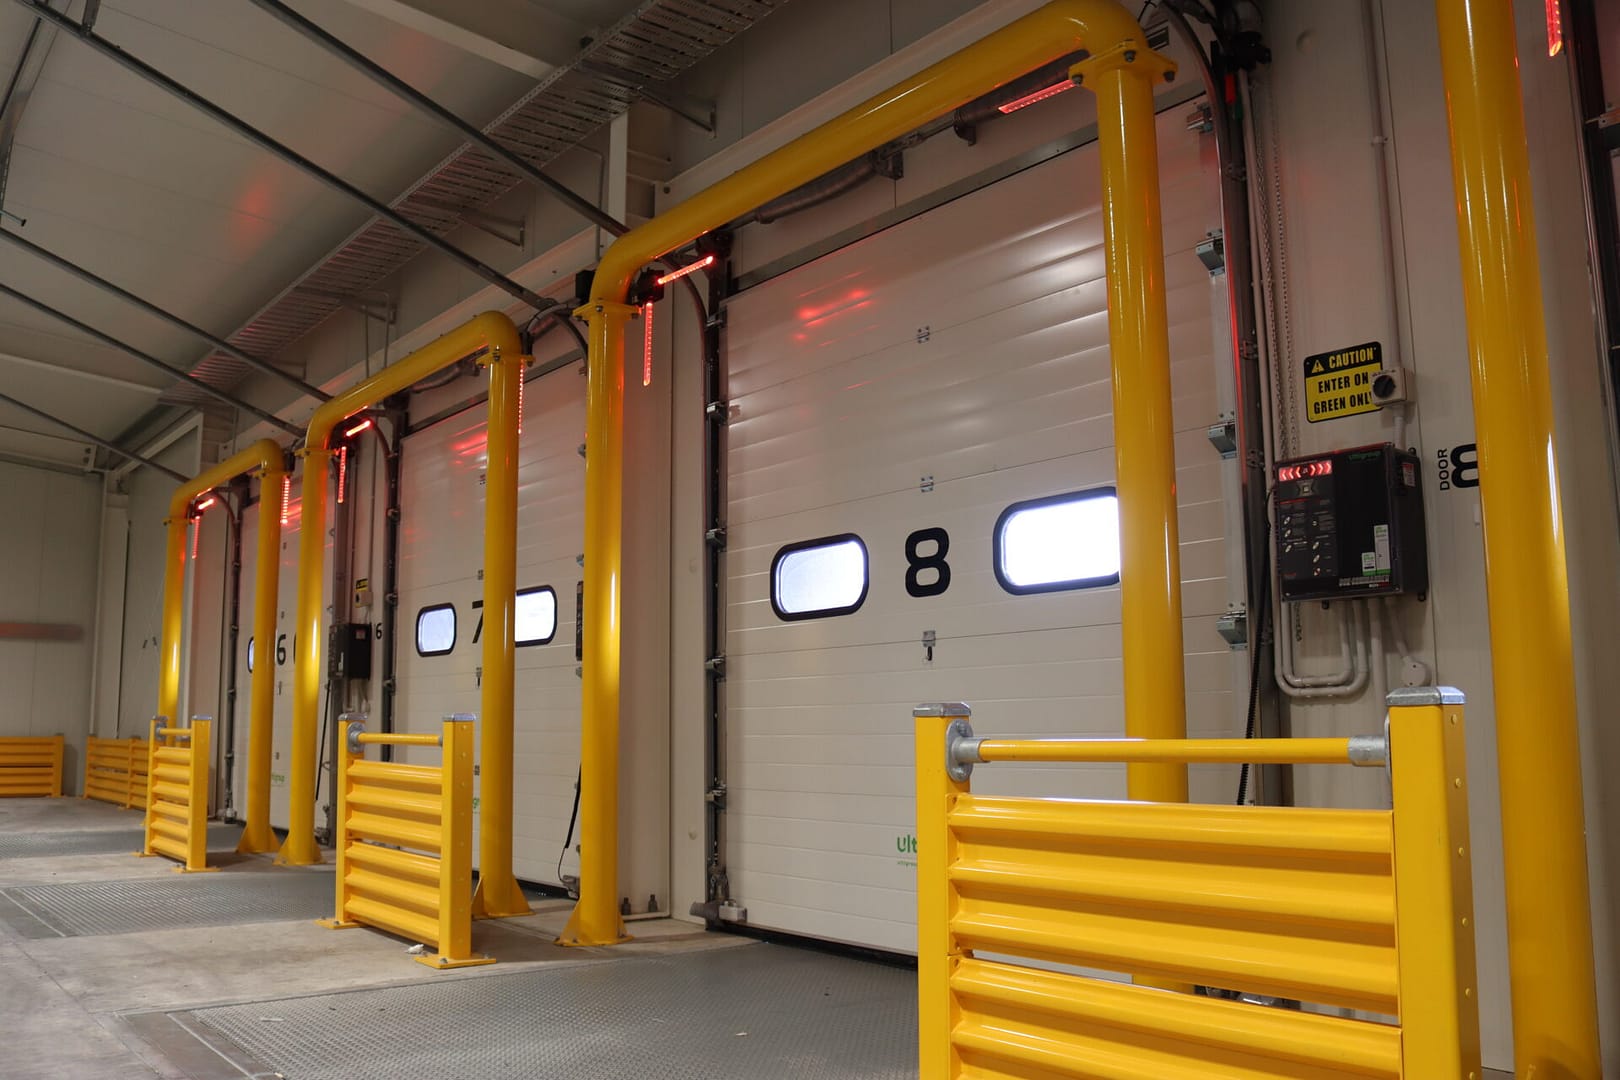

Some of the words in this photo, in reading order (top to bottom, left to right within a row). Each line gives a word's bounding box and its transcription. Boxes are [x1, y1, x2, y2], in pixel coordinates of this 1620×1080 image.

[1329, 347, 1373, 369] CAUTION
[1318, 376, 1350, 393] ENTER
[1314, 396, 1346, 414] GREEN
[1438, 448, 1450, 490] DOOR
[905, 526, 951, 598] 8
[376, 622, 383, 640] 6
[276, 634, 287, 666] 6
[897, 835, 917, 853] ult
